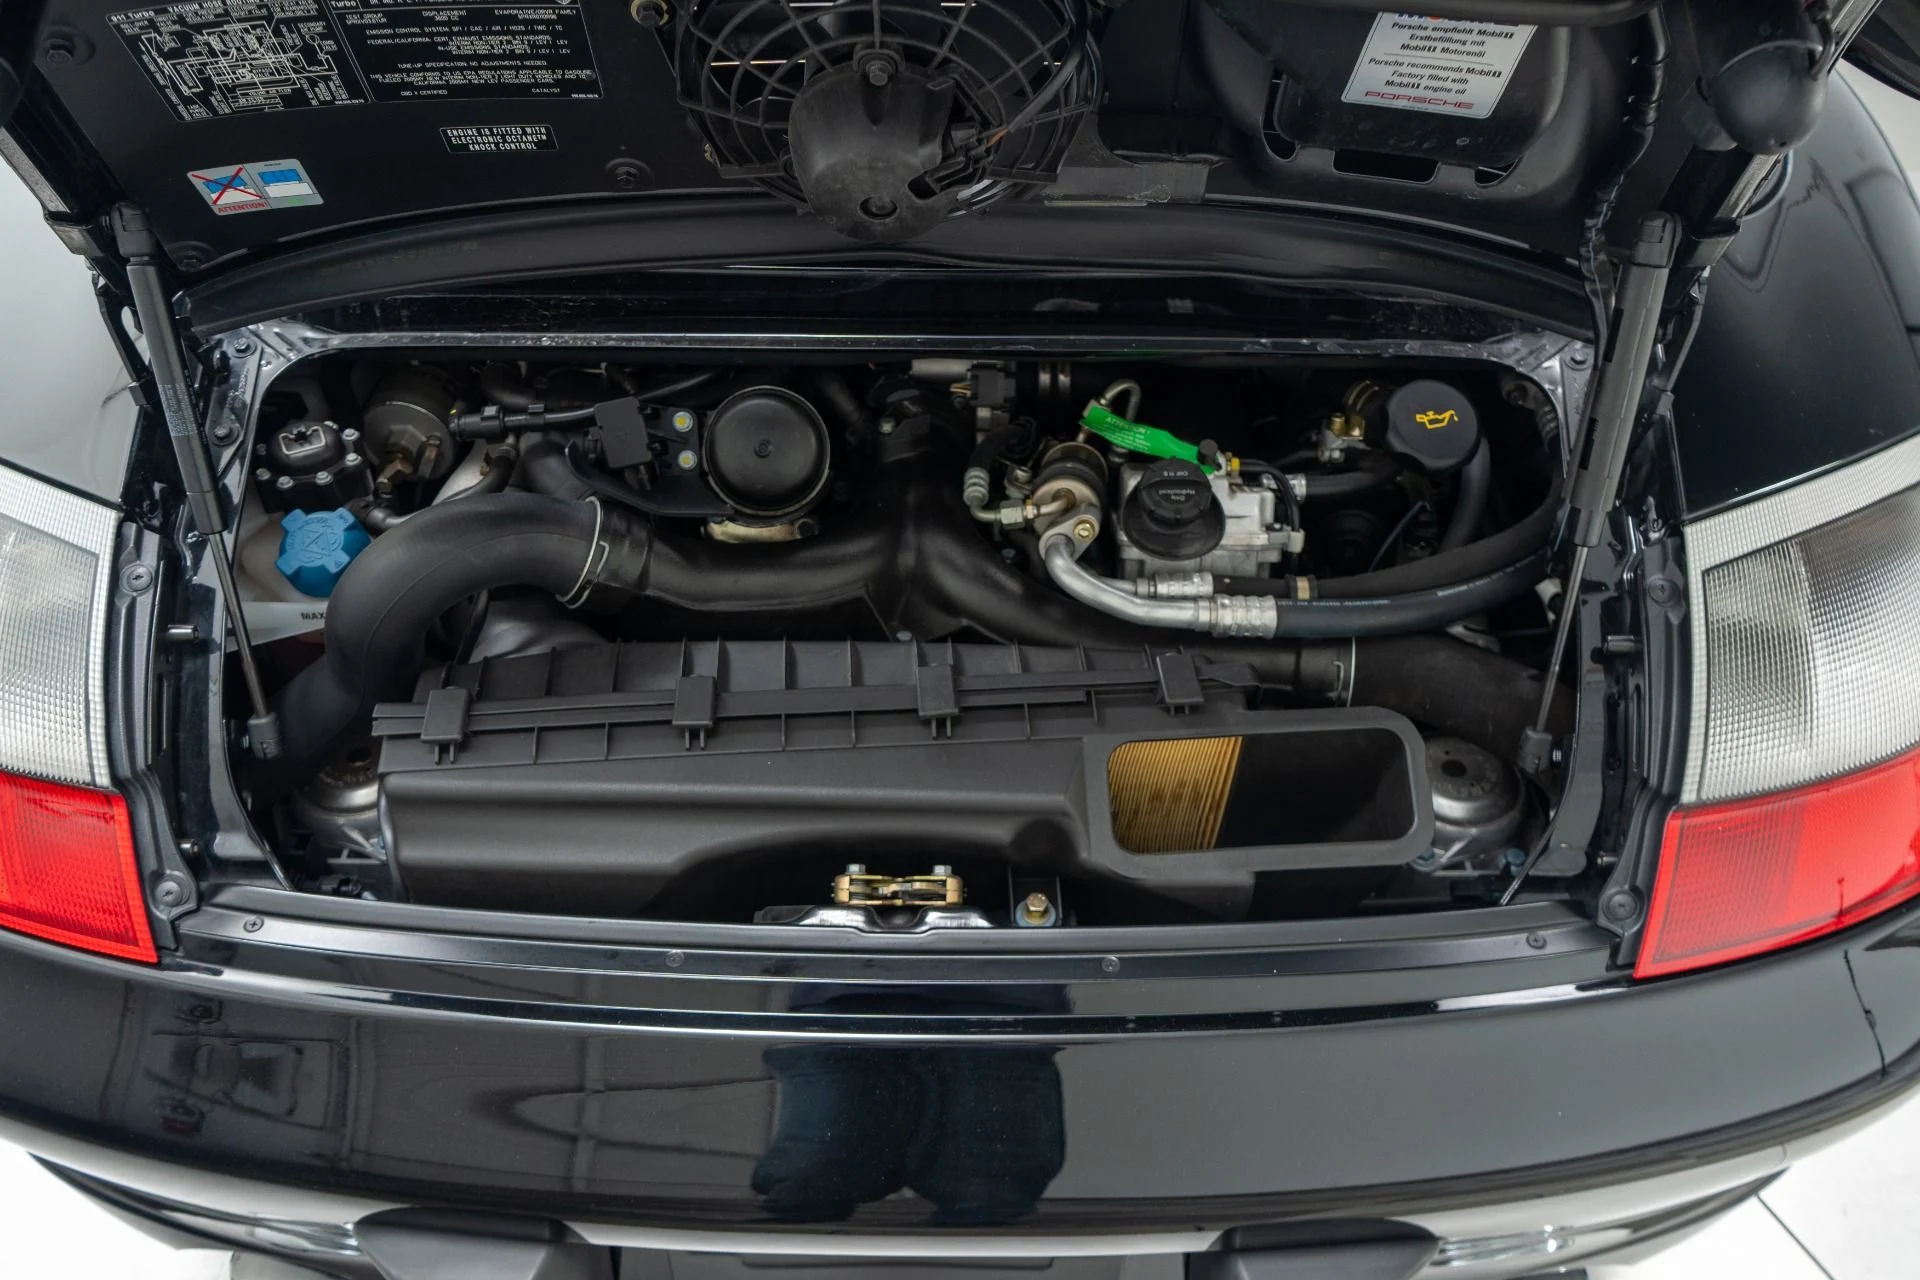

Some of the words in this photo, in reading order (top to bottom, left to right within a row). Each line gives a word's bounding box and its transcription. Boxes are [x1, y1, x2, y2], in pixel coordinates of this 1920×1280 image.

[111, 14, 126, 22] 911
[128, 10, 155, 19] Turbo
[167, 3, 200, 13] VACUUM
[201, 0, 224, 8] HOSE
[1391, 21, 1429, 32] Porsche
[1432, 26, 1475, 36] empfiehlt
[1409, 33, 1468, 47] Erstbefüllung
[1470, 38, 1487, 47] mit
[1440, 47, 1487, 58] Motorenöl
[1368, 57, 1404, 68] Porsche
[1406, 62, 1464, 74] recommends
[1391, 70, 1425, 82] Factory
[1427, 74, 1449, 83] filled
[1450, 77, 1469, 86] with
[1423, 84, 1453, 94] engine
[1454, 87, 1468, 96] oil
[1364, 91, 1474, 109] PORSCHE
[447, 128, 478, 137] ENGINE
[481, 127, 490, 136] IS
[493, 127, 522, 135] FITTED
[525, 126, 547, 135] WITH
[451, 135, 503, 144] ELECTRONIC
[468, 143, 497, 151] KNOCK
[499, 142, 537, 150] CONTROL
[300, 611, 326, 621] MAX
